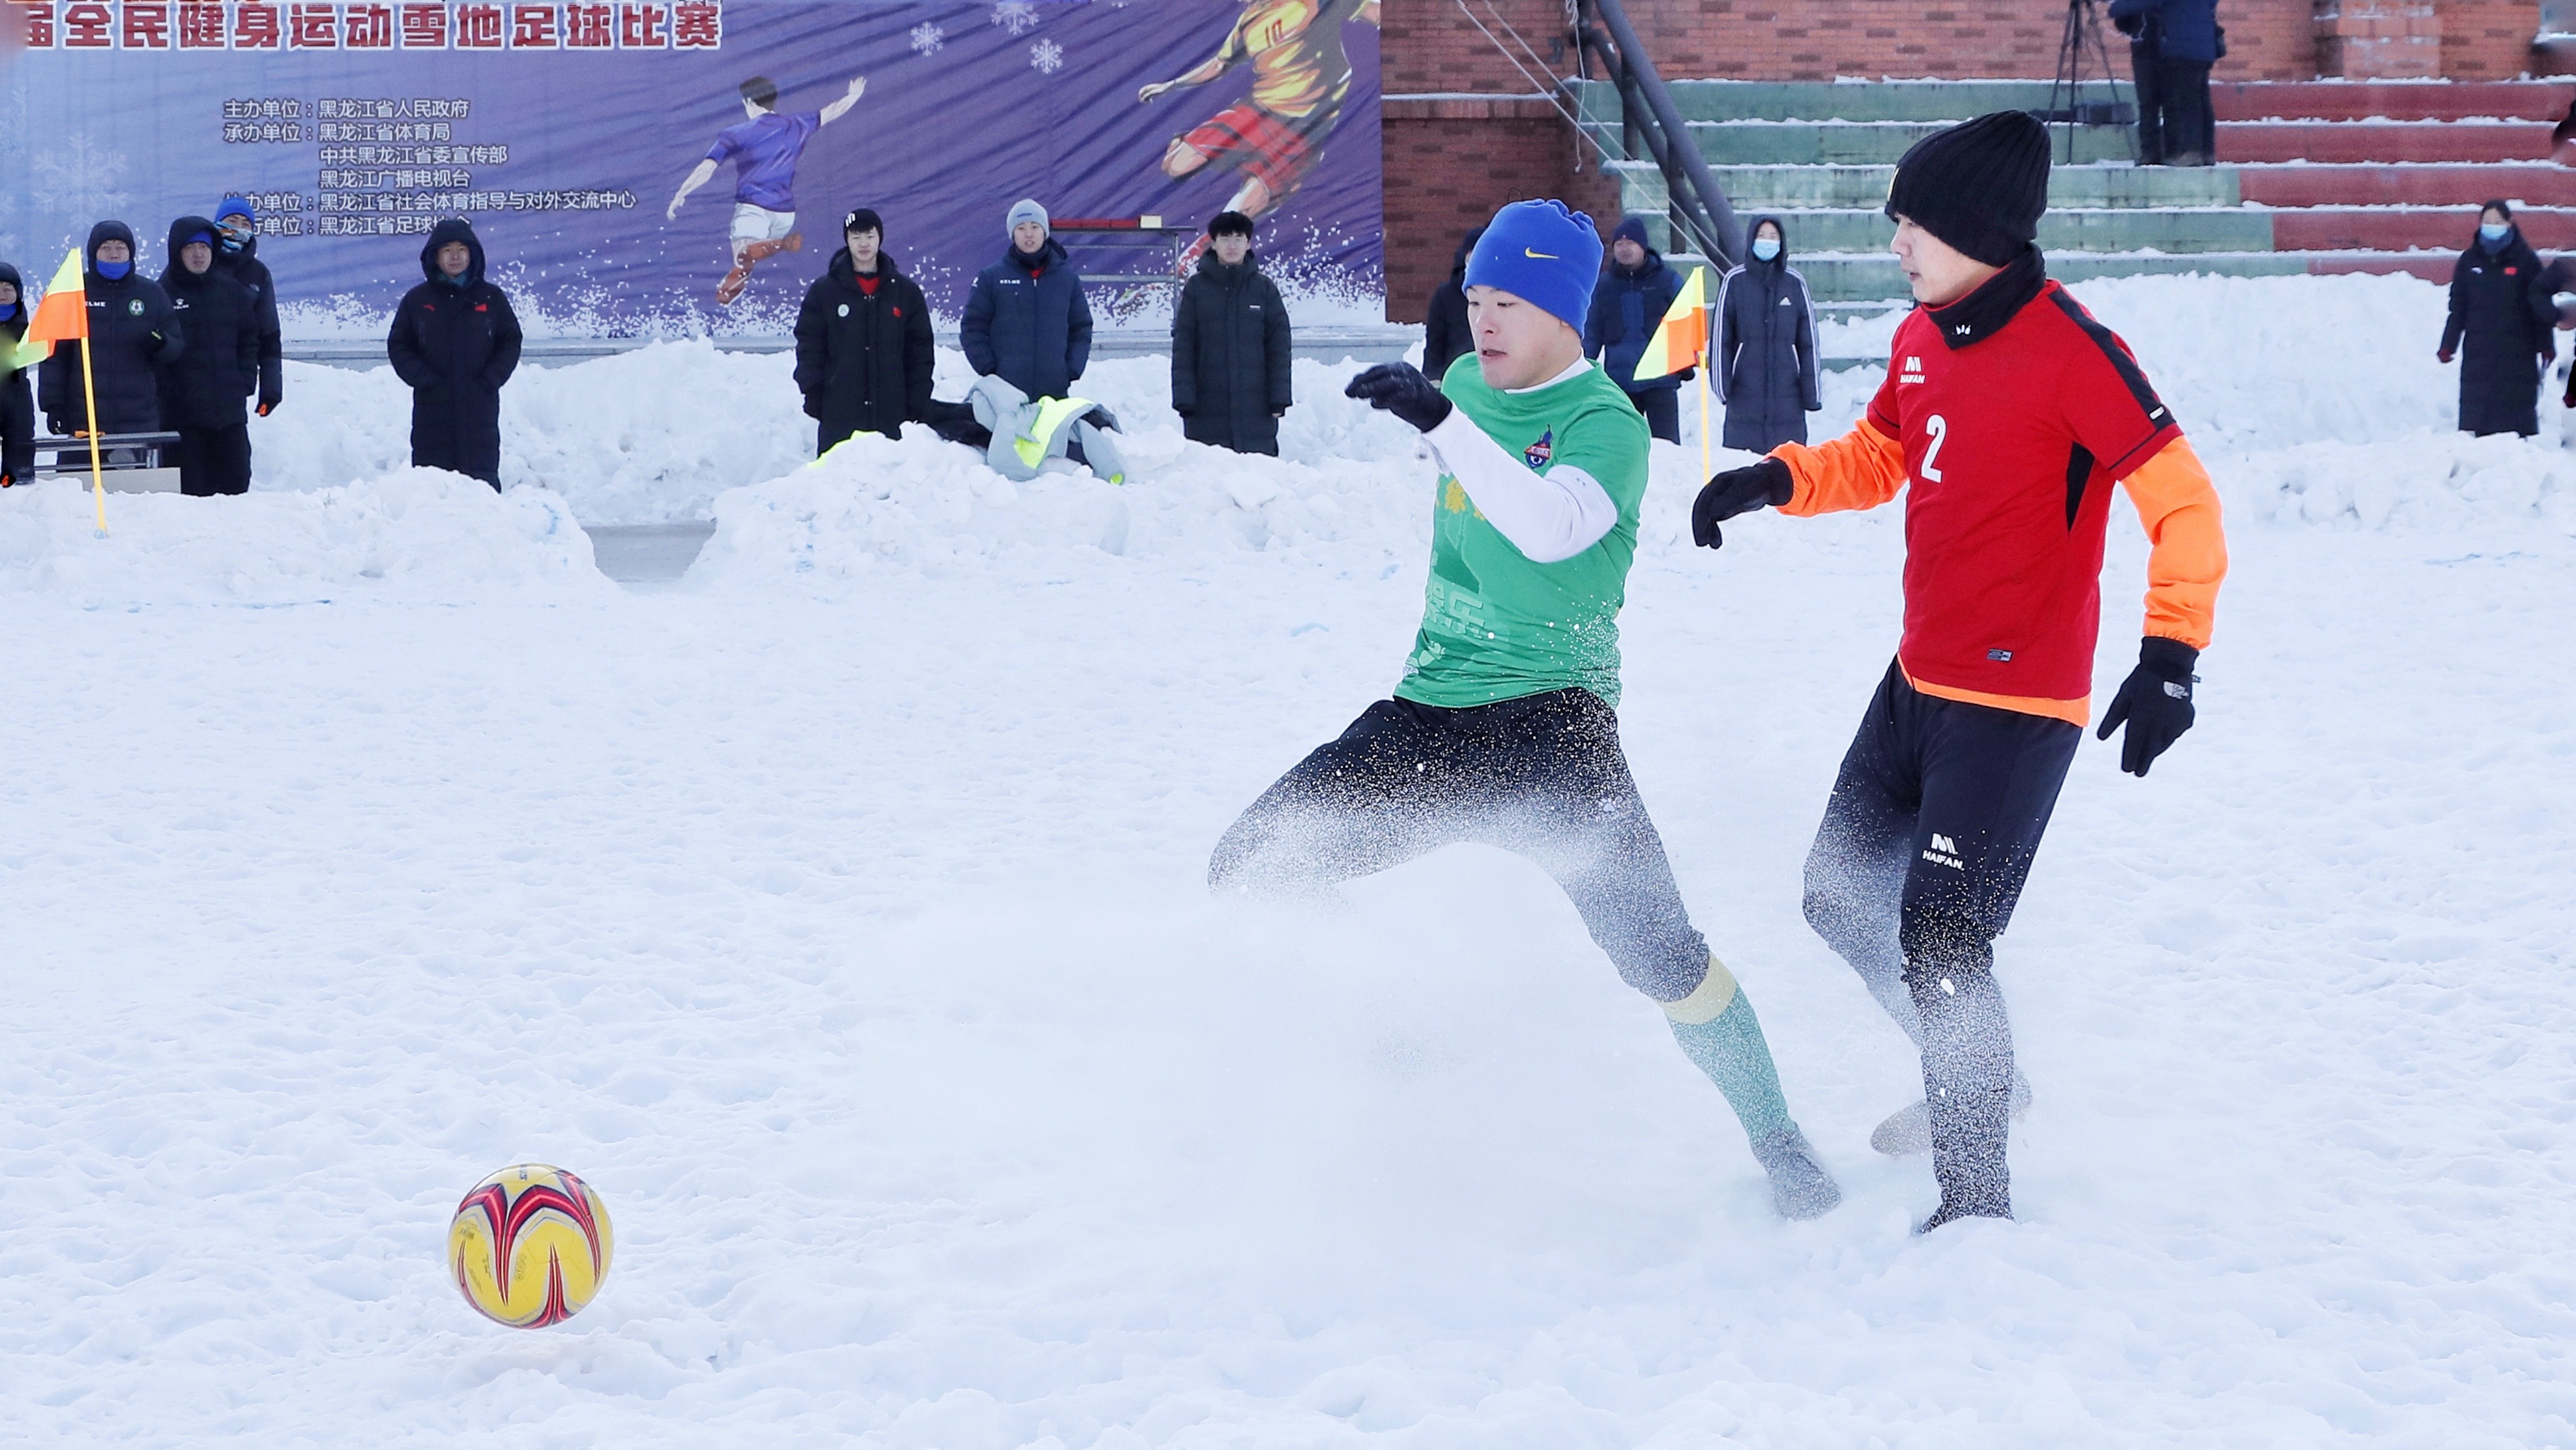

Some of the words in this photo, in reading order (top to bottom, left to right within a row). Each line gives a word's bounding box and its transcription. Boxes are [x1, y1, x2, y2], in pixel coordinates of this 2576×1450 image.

[224, 99, 470, 119] 主办单位：黑龙江省人民政府
[224, 123, 451, 142] 承办单位：黑龙江省体育局
[319, 145, 508, 164] 中共黑龙江省委宣传部
[319, 169, 471, 188] 黑龙江广播电视台
[226, 190, 637, 212] 办单位：黑龙江省社会体育指导与对外交流中心
[1920, 414, 1947, 484] 2
